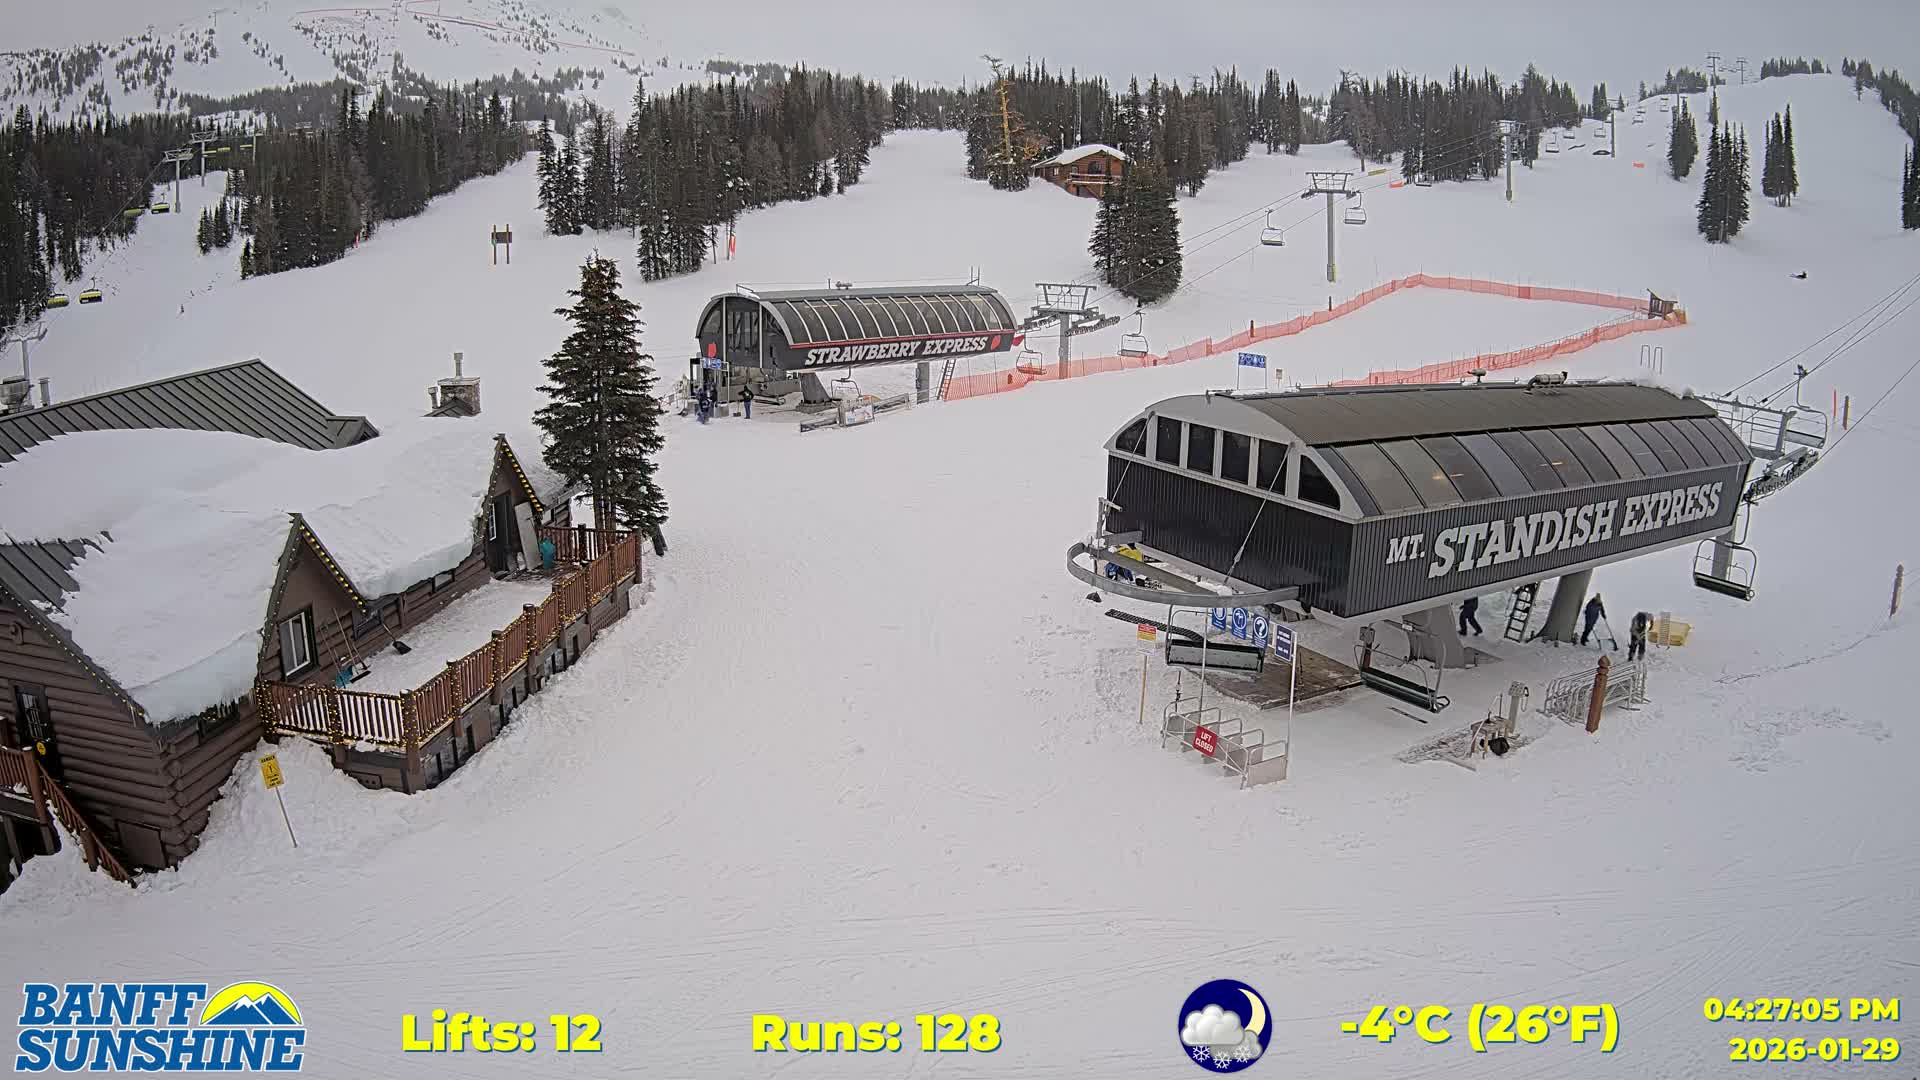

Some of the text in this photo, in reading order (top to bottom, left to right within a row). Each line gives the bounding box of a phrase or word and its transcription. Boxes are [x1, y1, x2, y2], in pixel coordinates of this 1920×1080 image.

[804, 336, 989, 366] STRAWBERRY EXPRESS
[1385, 481, 1723, 579] MT. STANDISH EXPRESS
[1195, 737, 1214, 753] CLOSED
[1200, 731, 1212, 743] LIFT
